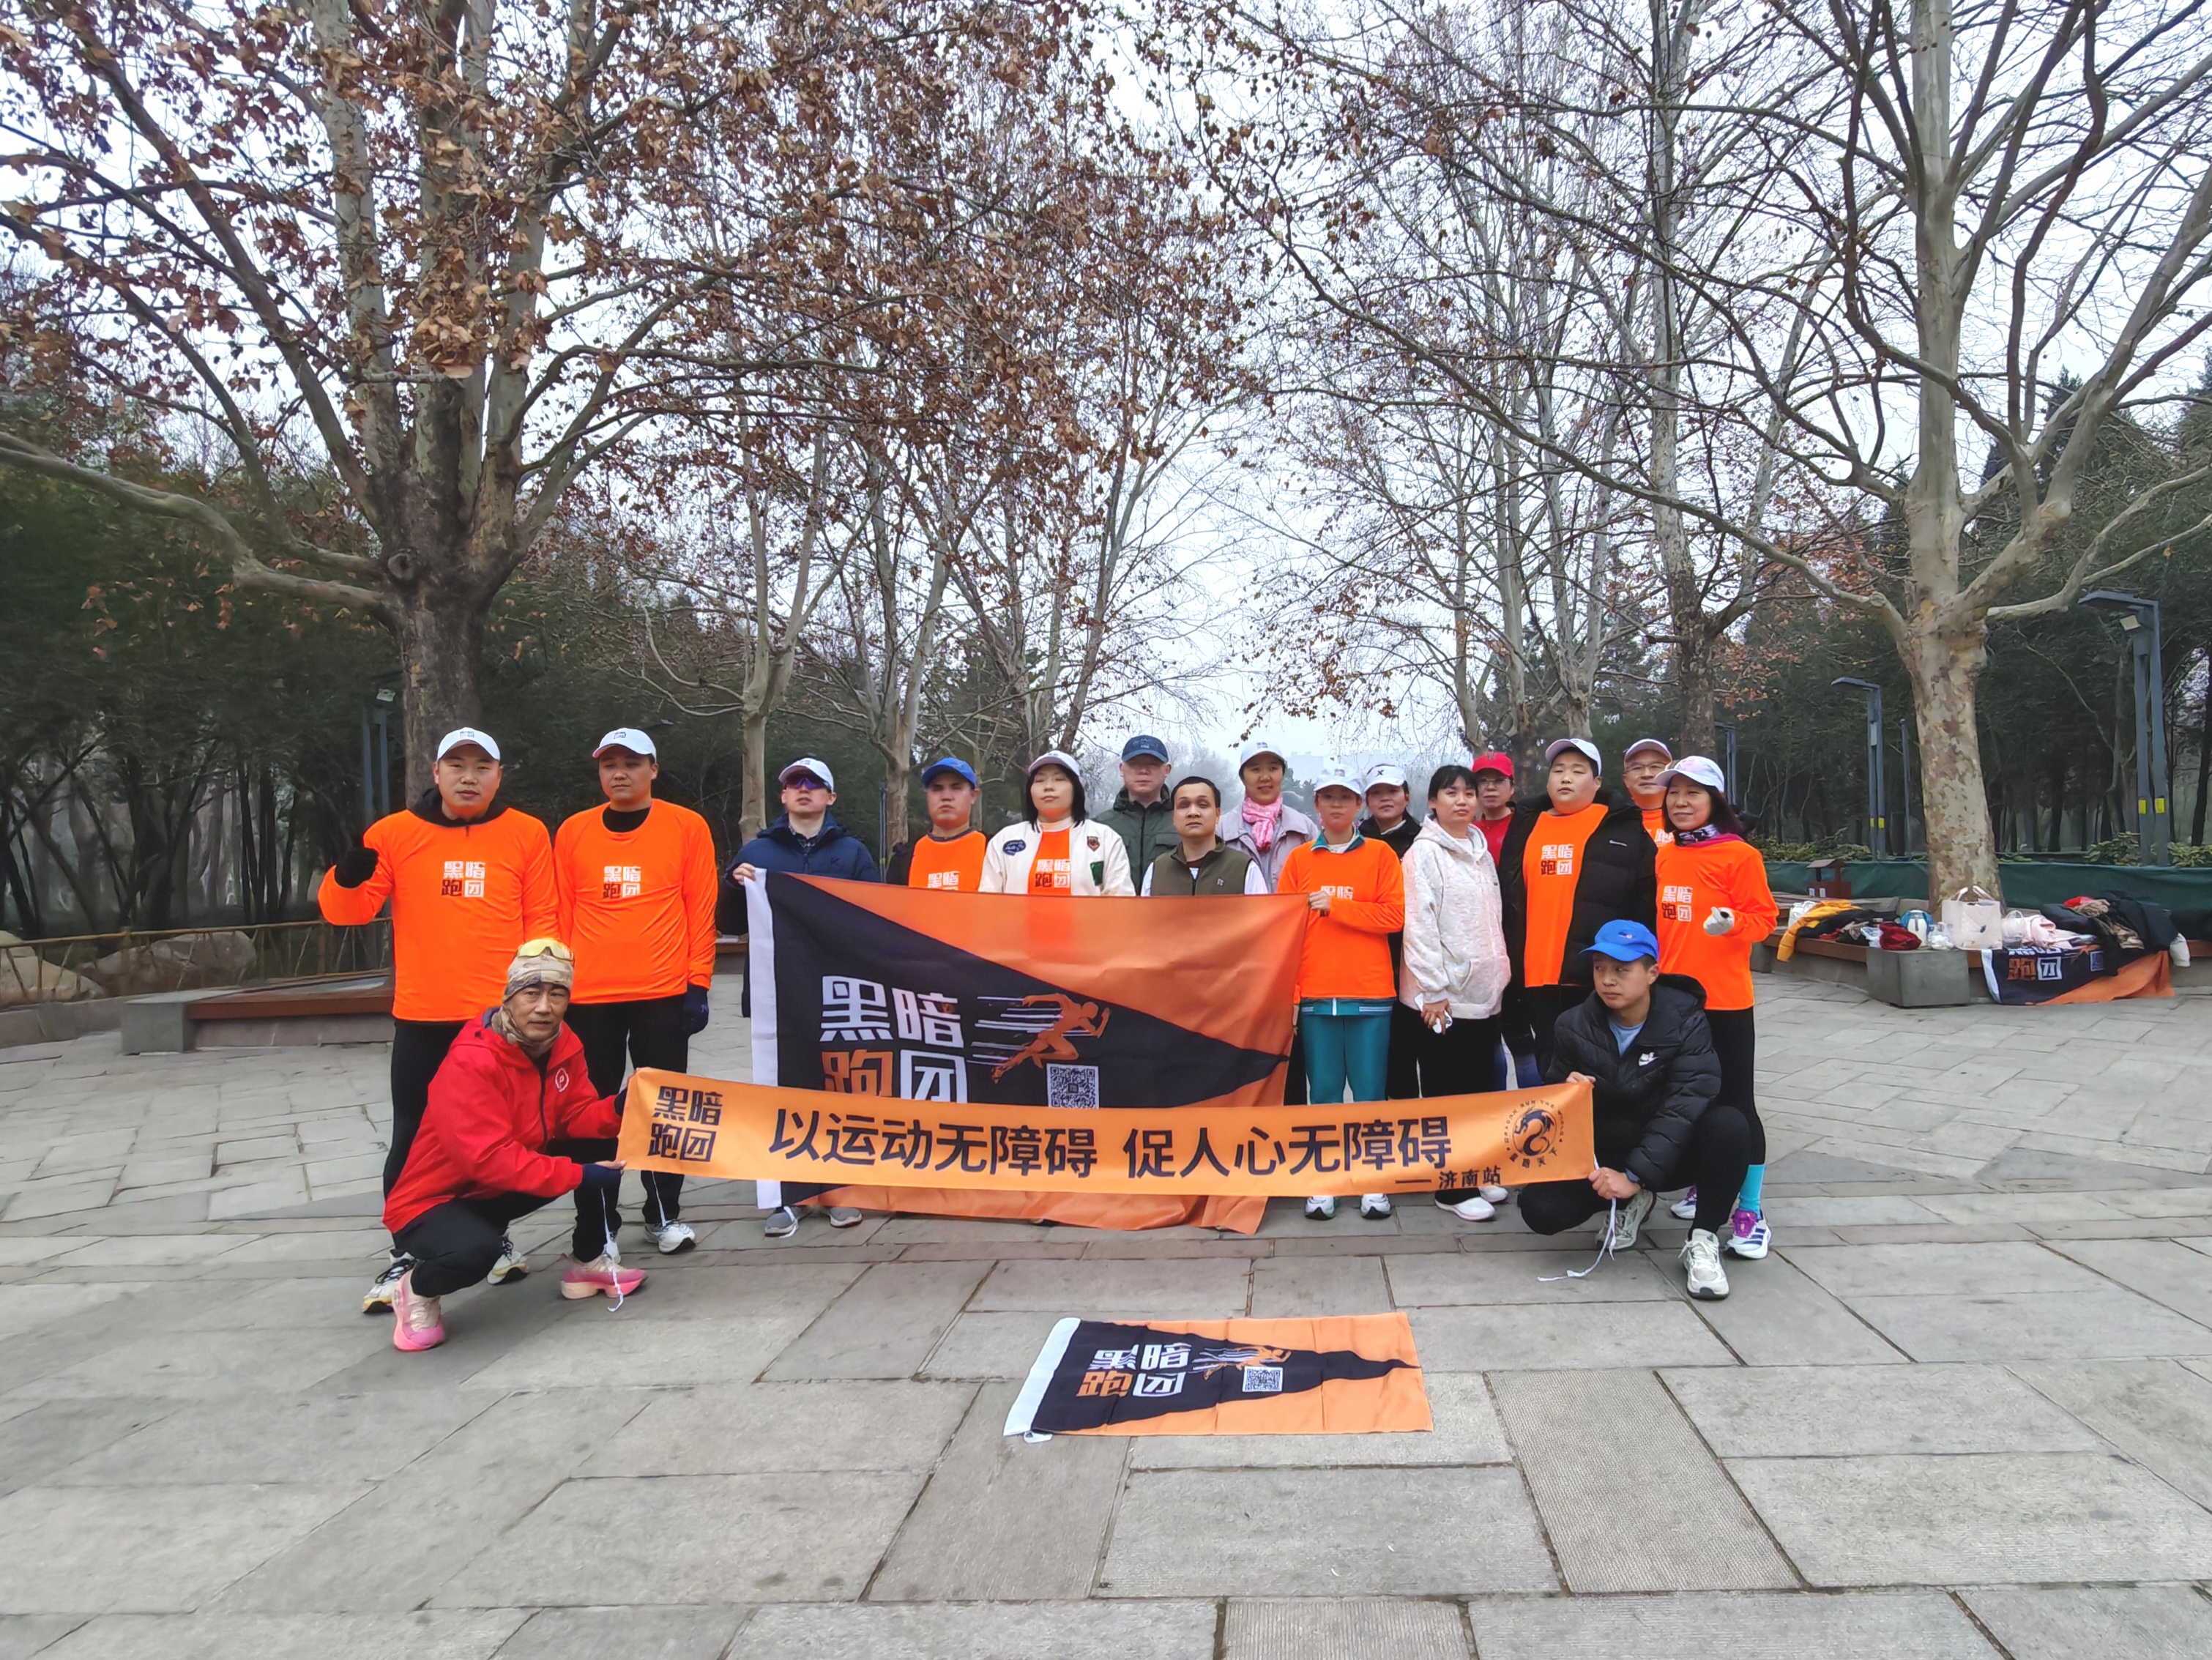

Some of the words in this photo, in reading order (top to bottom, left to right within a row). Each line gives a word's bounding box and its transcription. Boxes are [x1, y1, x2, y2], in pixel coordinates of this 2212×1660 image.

[1541, 844, 1574, 860] 黑暗
[444, 860, 486, 879] 黑暗
[604, 866, 641, 882] 黑暗
[1541, 860, 1572, 876] 跑团
[442, 879, 484, 898] 跑团
[927, 871, 960, 888] 黑暗
[603, 882, 641, 899] 跑团
[1662, 885, 1693, 904] 黑暗
[1661, 903, 1692, 923] 跑团
[819, 975, 964, 1048] 黑暗
[652, 1085, 723, 1126] 黑暗
[647, 1123, 718, 1162] 跑团
[768, 1108, 1098, 1178] 以运动无障碍
[1122, 1115, 1453, 1179] 促人心无障碍
[1087, 1342, 1192, 1371] 黑暗
[1076, 1370, 1187, 1397] 跑团
